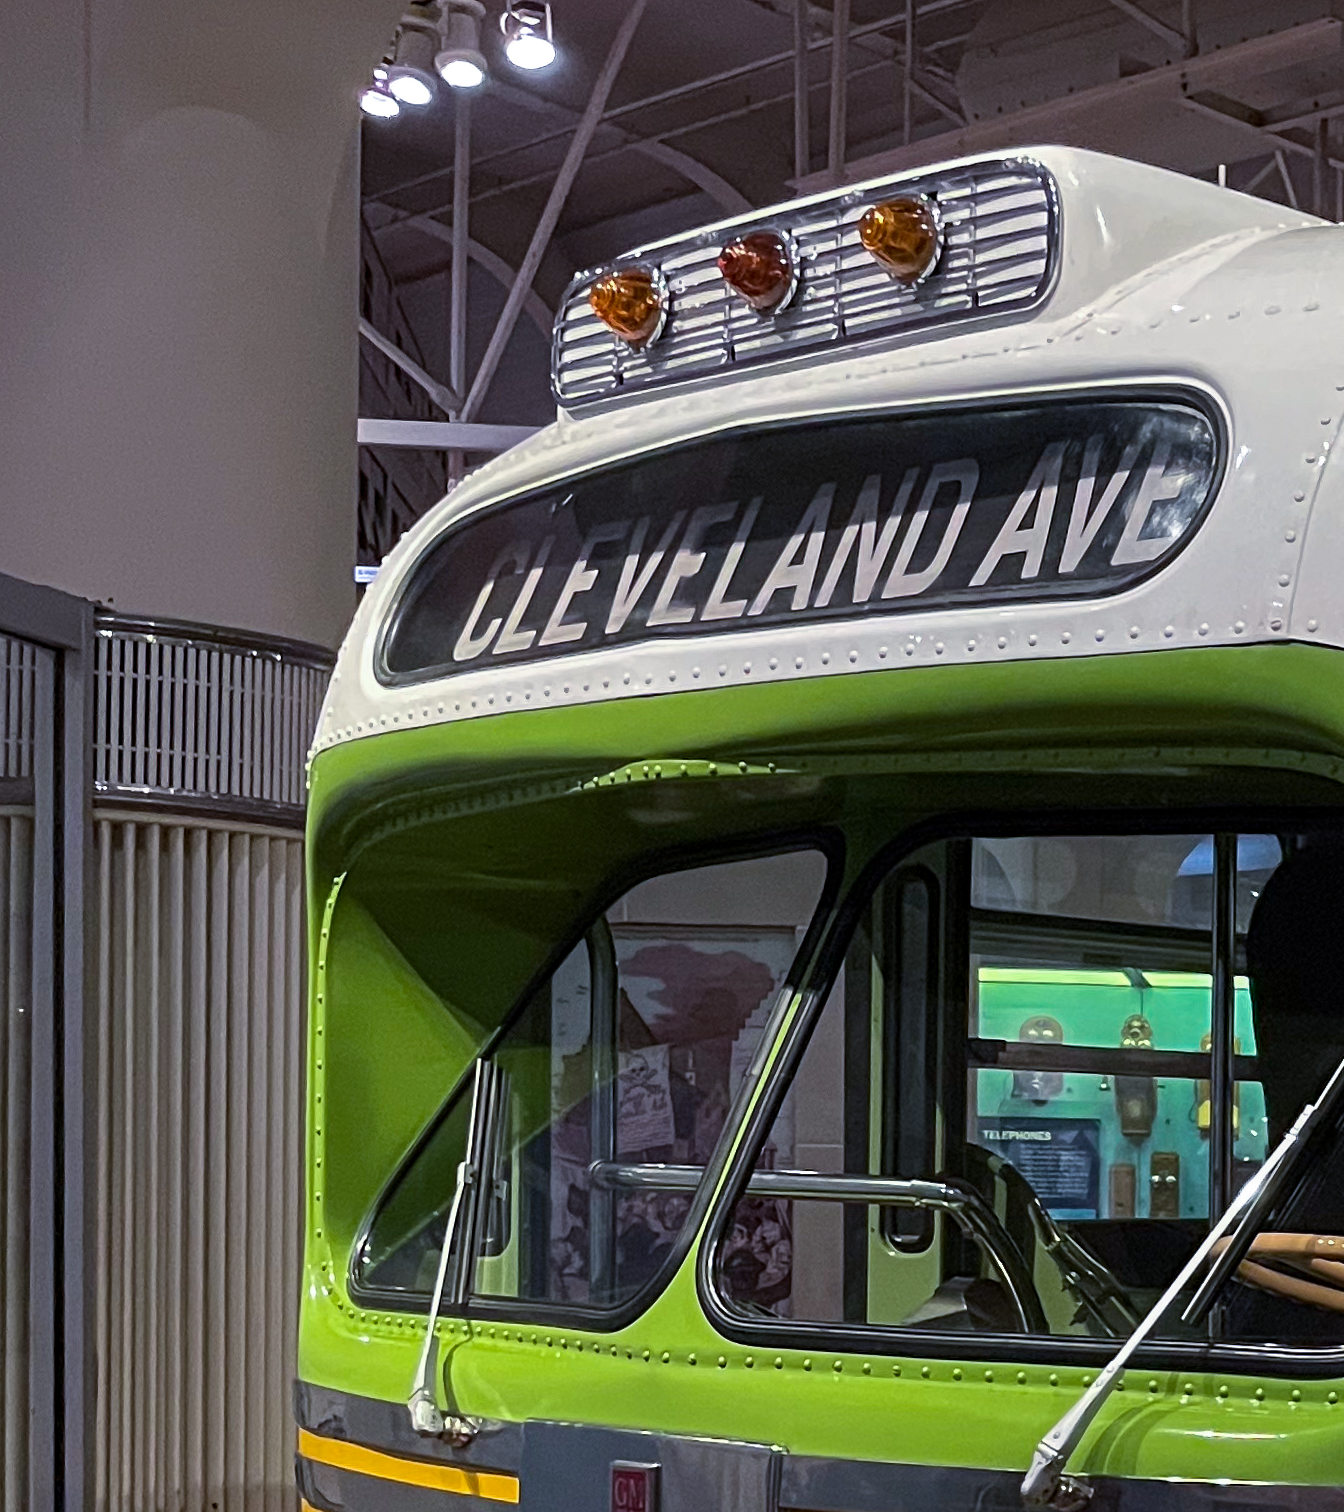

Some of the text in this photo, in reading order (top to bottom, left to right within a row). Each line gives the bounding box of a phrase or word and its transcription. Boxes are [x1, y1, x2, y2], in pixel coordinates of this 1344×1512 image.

[452, 434, 1192, 660] CLEVELAND AVE
[982, 1130, 1051, 1140] TELEPHONES
